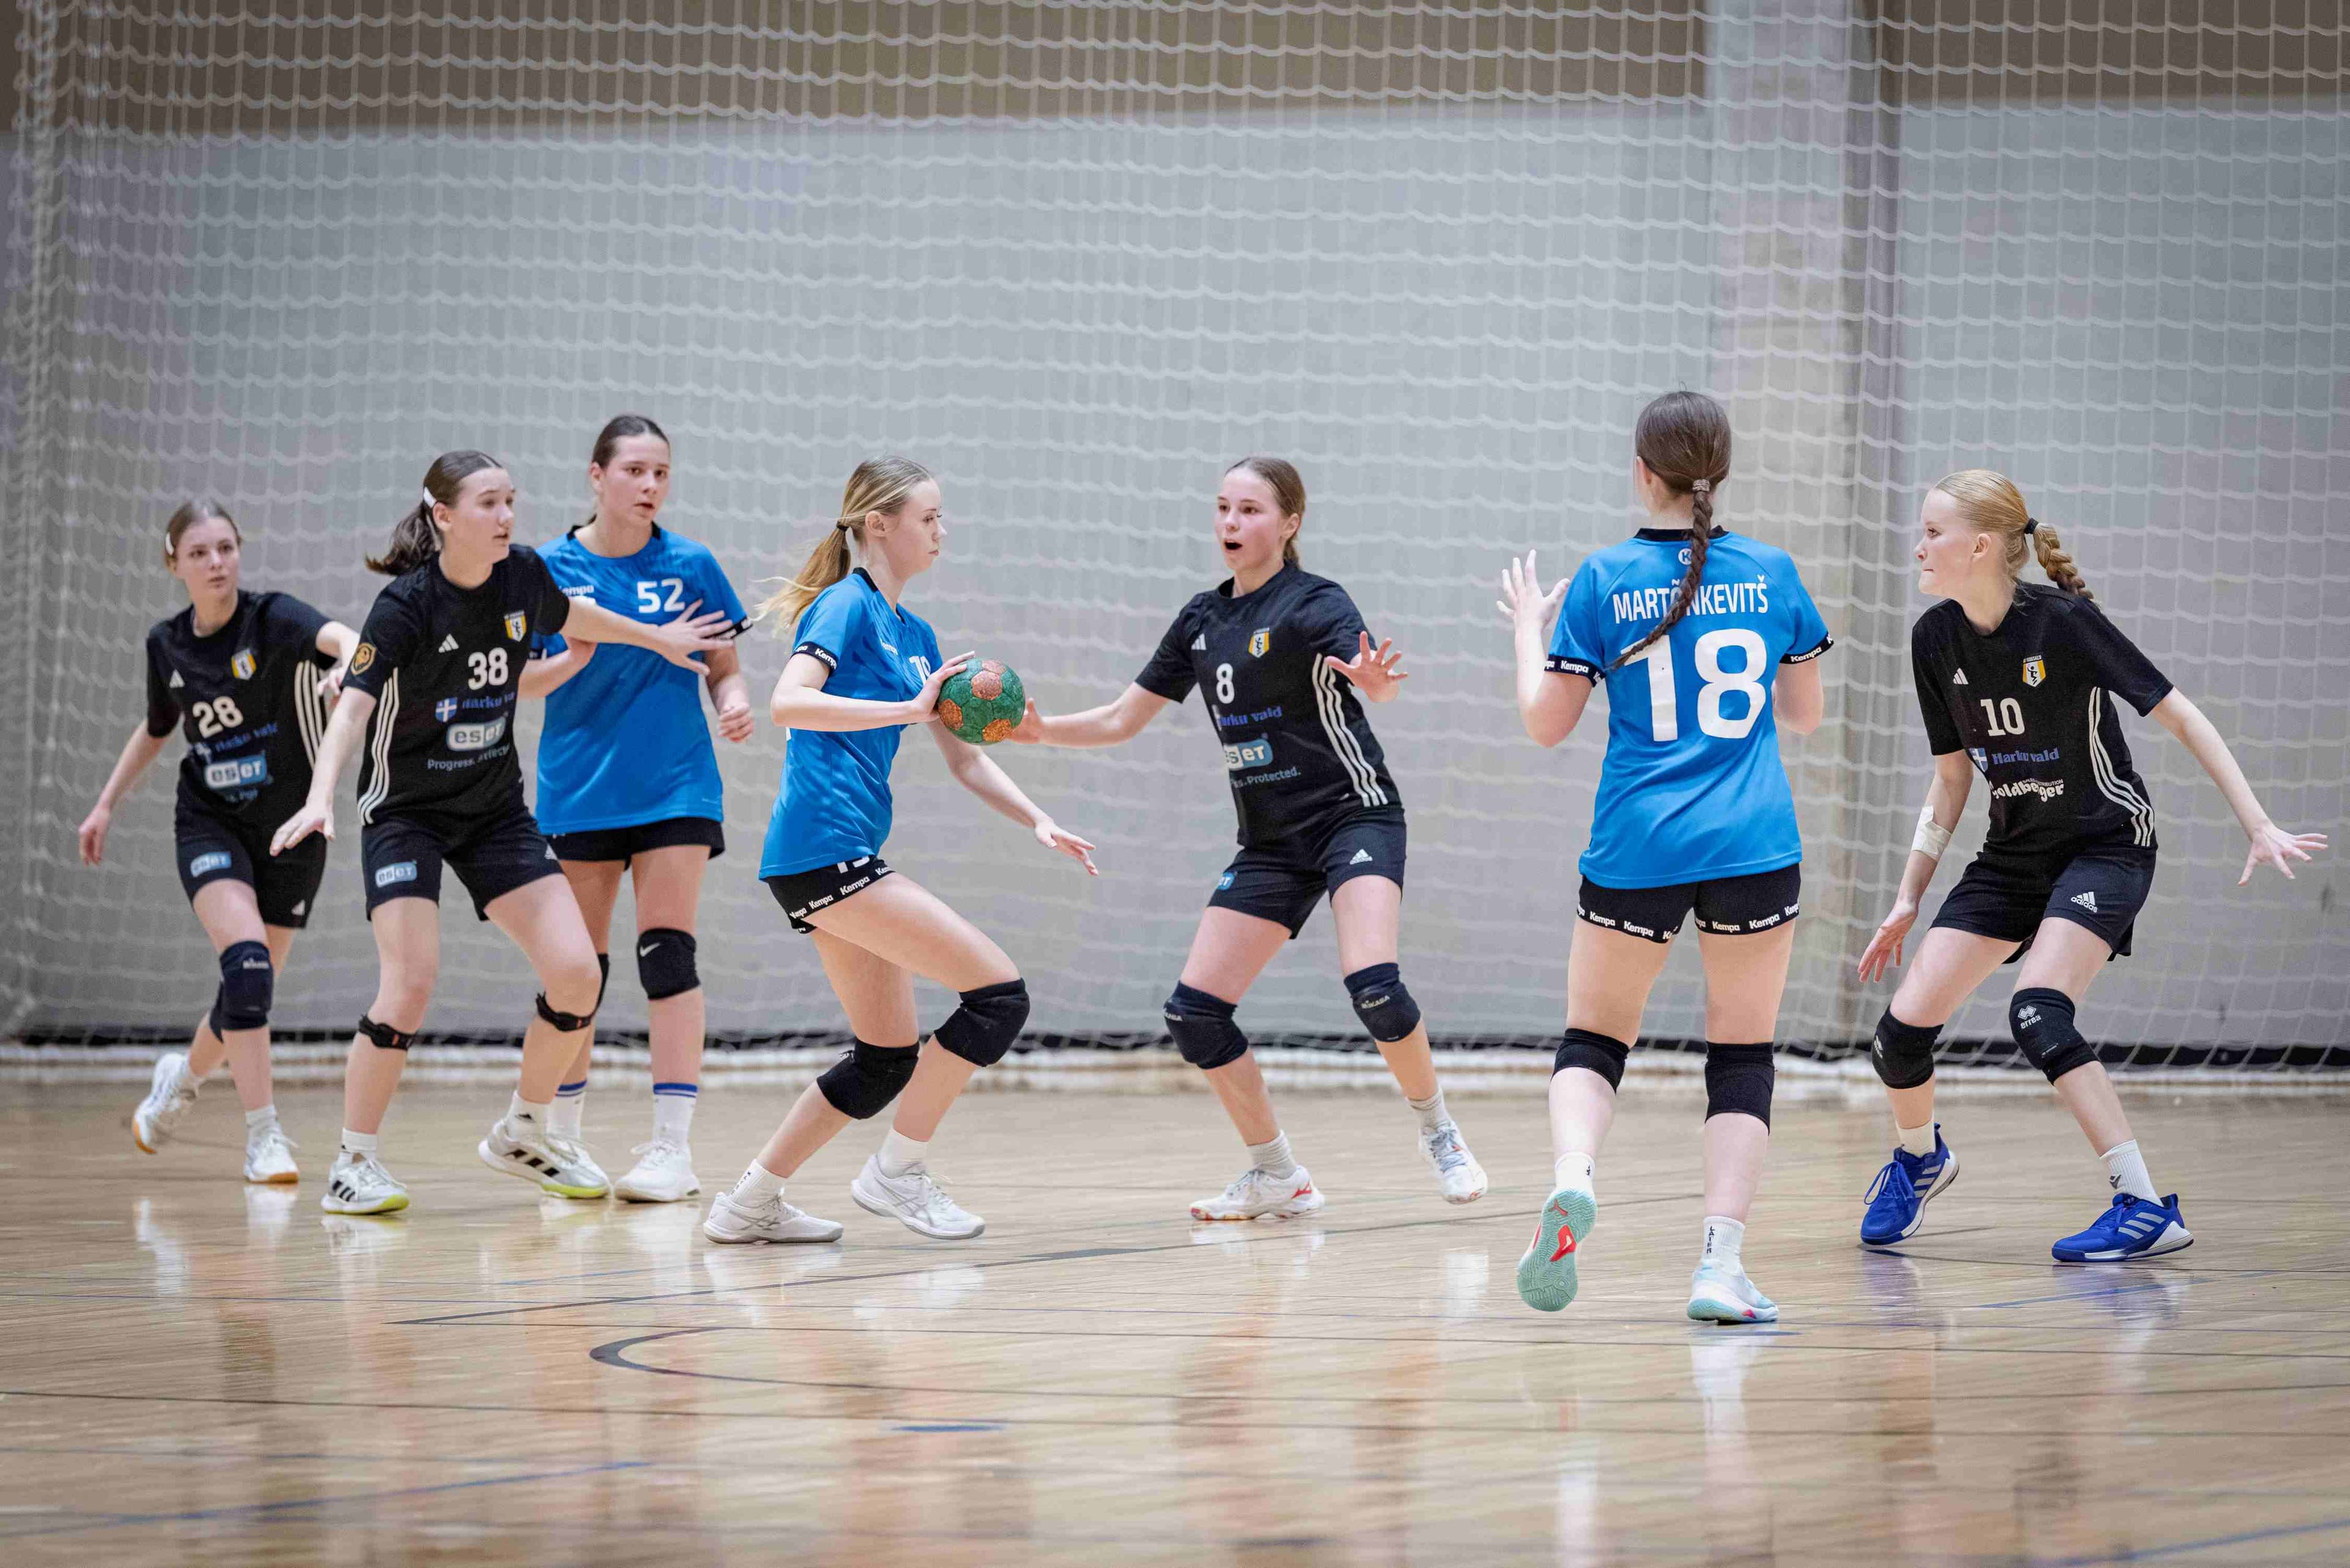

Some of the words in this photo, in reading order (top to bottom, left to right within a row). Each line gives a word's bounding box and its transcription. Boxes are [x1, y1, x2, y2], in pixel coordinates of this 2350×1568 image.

[558, 584, 595, 596] empa
[636, 578, 685, 613] 52
[1790, 646, 1822, 662] Kempa
[468, 647, 509, 690] 38
[1561, 660, 1589, 674] Kempa
[1215, 663, 1236, 704] 8
[1621, 628, 1767, 742] 18
[192, 695, 244, 738] 28
[1980, 698, 2026, 736] 10
[2029, 747, 2060, 763] vald
[840, 875, 870, 896] Kempa
[808, 894, 834, 910] Kempa
[1589, 911, 1616, 927] Kempa
[1624, 920, 1654, 937] Kempa
[1712, 920, 1740, 933] Kempa
[1748, 913, 1780, 930] Kempa
